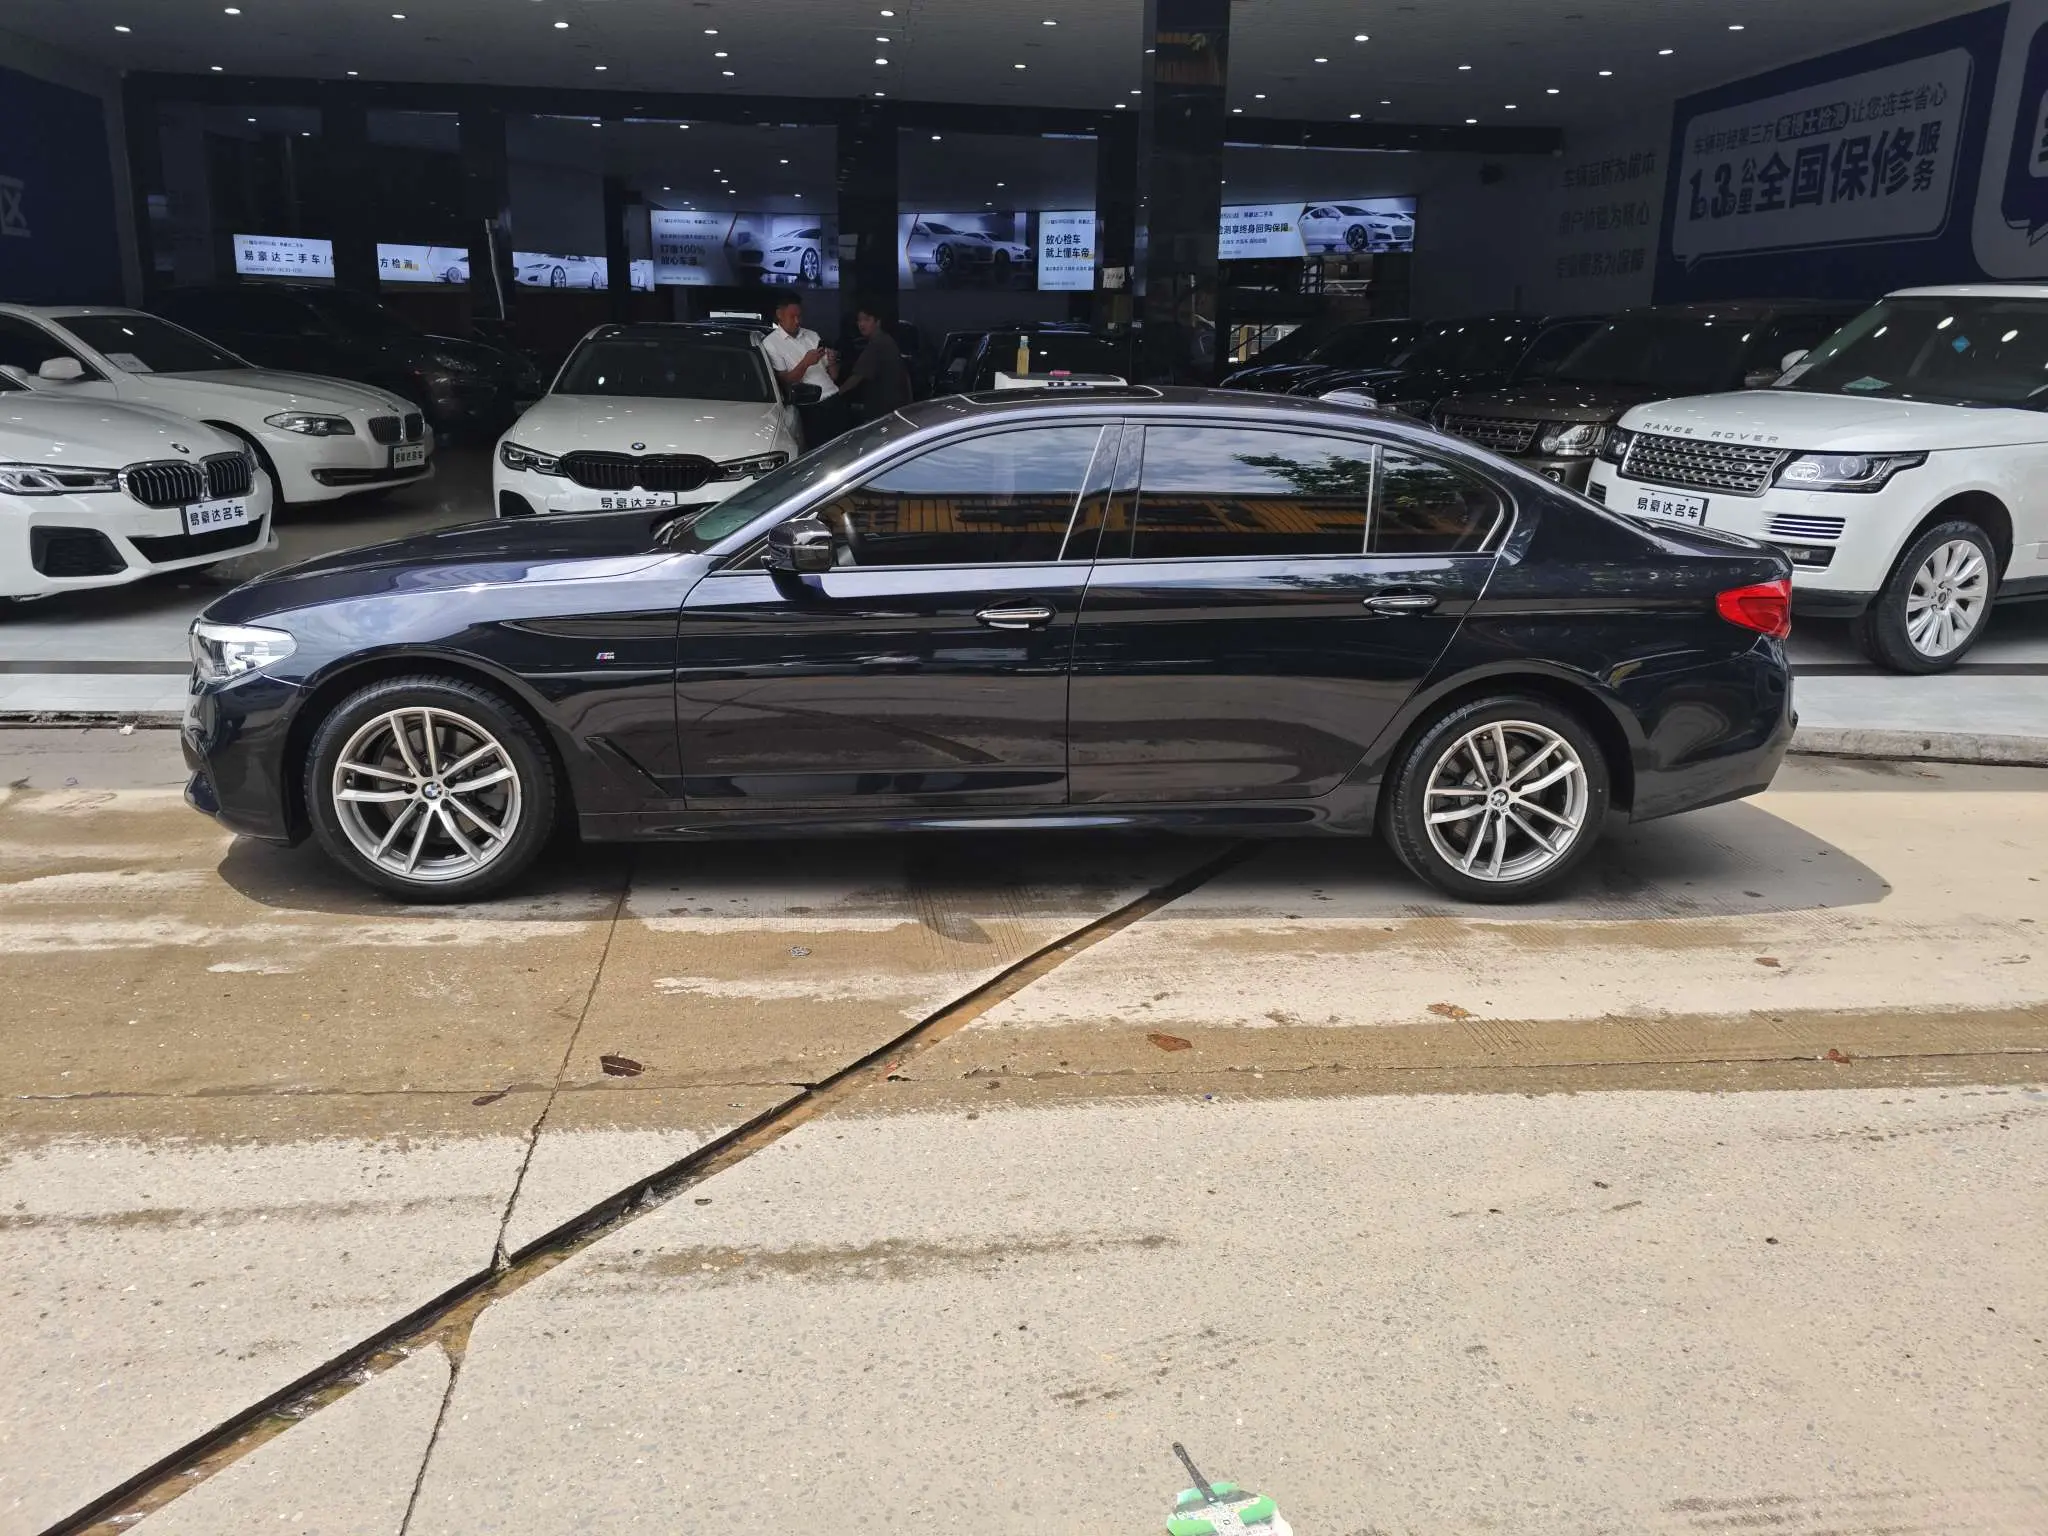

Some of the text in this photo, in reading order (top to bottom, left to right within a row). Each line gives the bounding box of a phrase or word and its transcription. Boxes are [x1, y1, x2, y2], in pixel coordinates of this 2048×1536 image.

[1852, 82, 1948, 122] 让您选车省心
[1045, 234, 1081, 245] 放心检车
[1045, 247, 1090, 259] 就上懂车帝
[1643, 422, 1780, 444] RANGE ROVER
[189, 504, 245, 527] 易豪达名车
[1636, 496, 1700, 519] 易豪达名车
